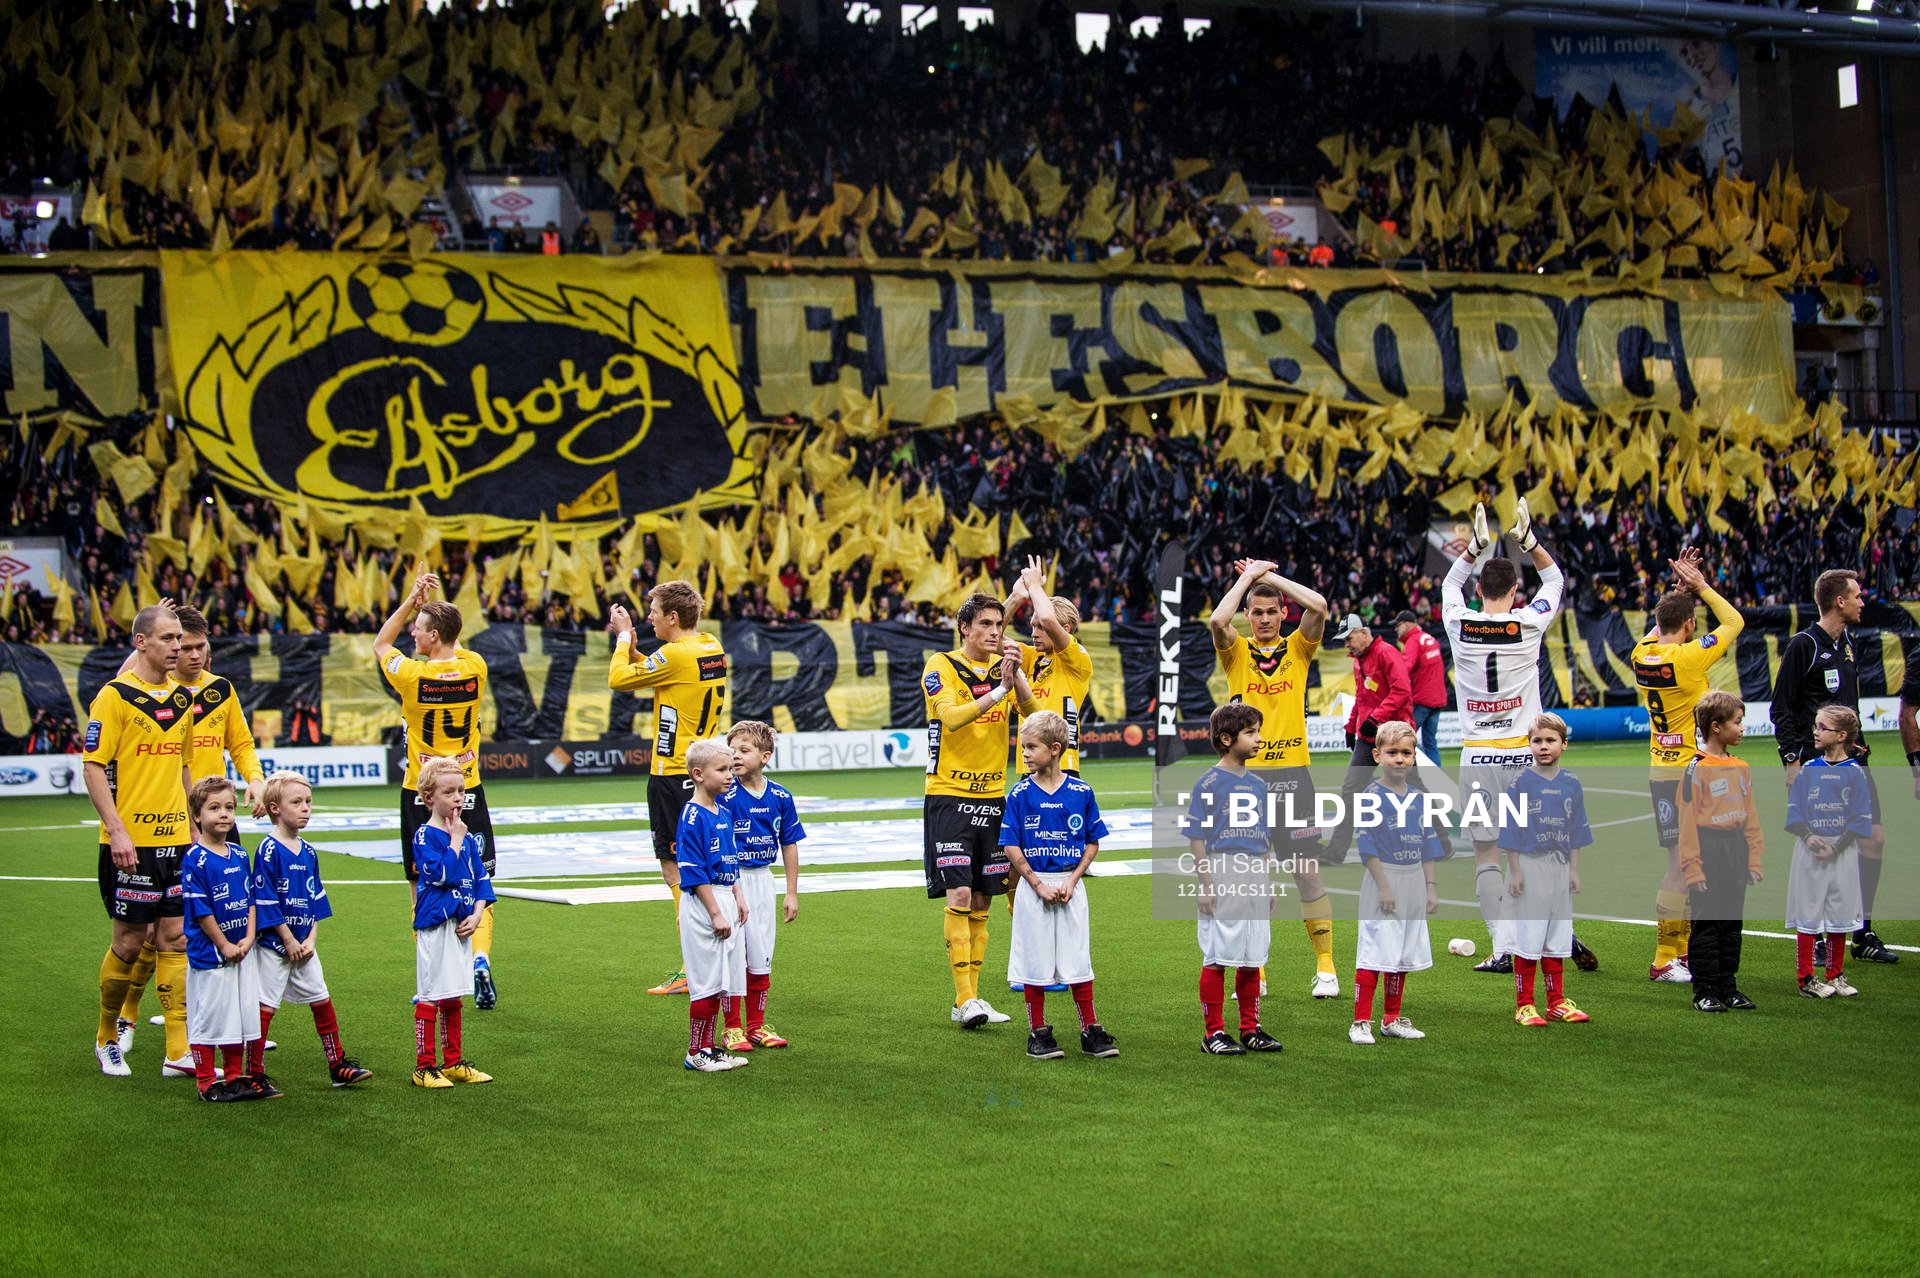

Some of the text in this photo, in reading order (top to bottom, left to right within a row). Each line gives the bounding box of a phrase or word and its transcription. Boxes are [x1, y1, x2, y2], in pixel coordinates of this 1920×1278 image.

[297, 352, 672, 498] Elfsborg
[1463, 624, 1505, 634] Swedbank
[1158, 577, 1182, 735] REKYL
[1486, 651, 1499, 693] 1
[422, 683, 464, 692] Swedbank
[1468, 697, 1521, 712] TEAM SPORTIA
[1648, 690, 1668, 733] 8
[422, 706, 472, 748] 14
[1474, 718, 1513, 727] COOPER
[790, 732, 877, 769] travel
[1264, 751, 1285, 761] BIL
[1471, 754, 1534, 766] COOPER
[951, 769, 1003, 781] TOVEKS
[969, 782, 990, 791] BIL
[1068, 782, 1086, 792] NCC
[957, 803, 1002, 817] TOVEKS
[971, 816, 990, 827] BIL
[153, 826, 176, 837] BIL
[156, 847, 178, 858] BIL
[1024, 844, 1082, 858] team:olivia
[115, 901, 127, 916] 22
